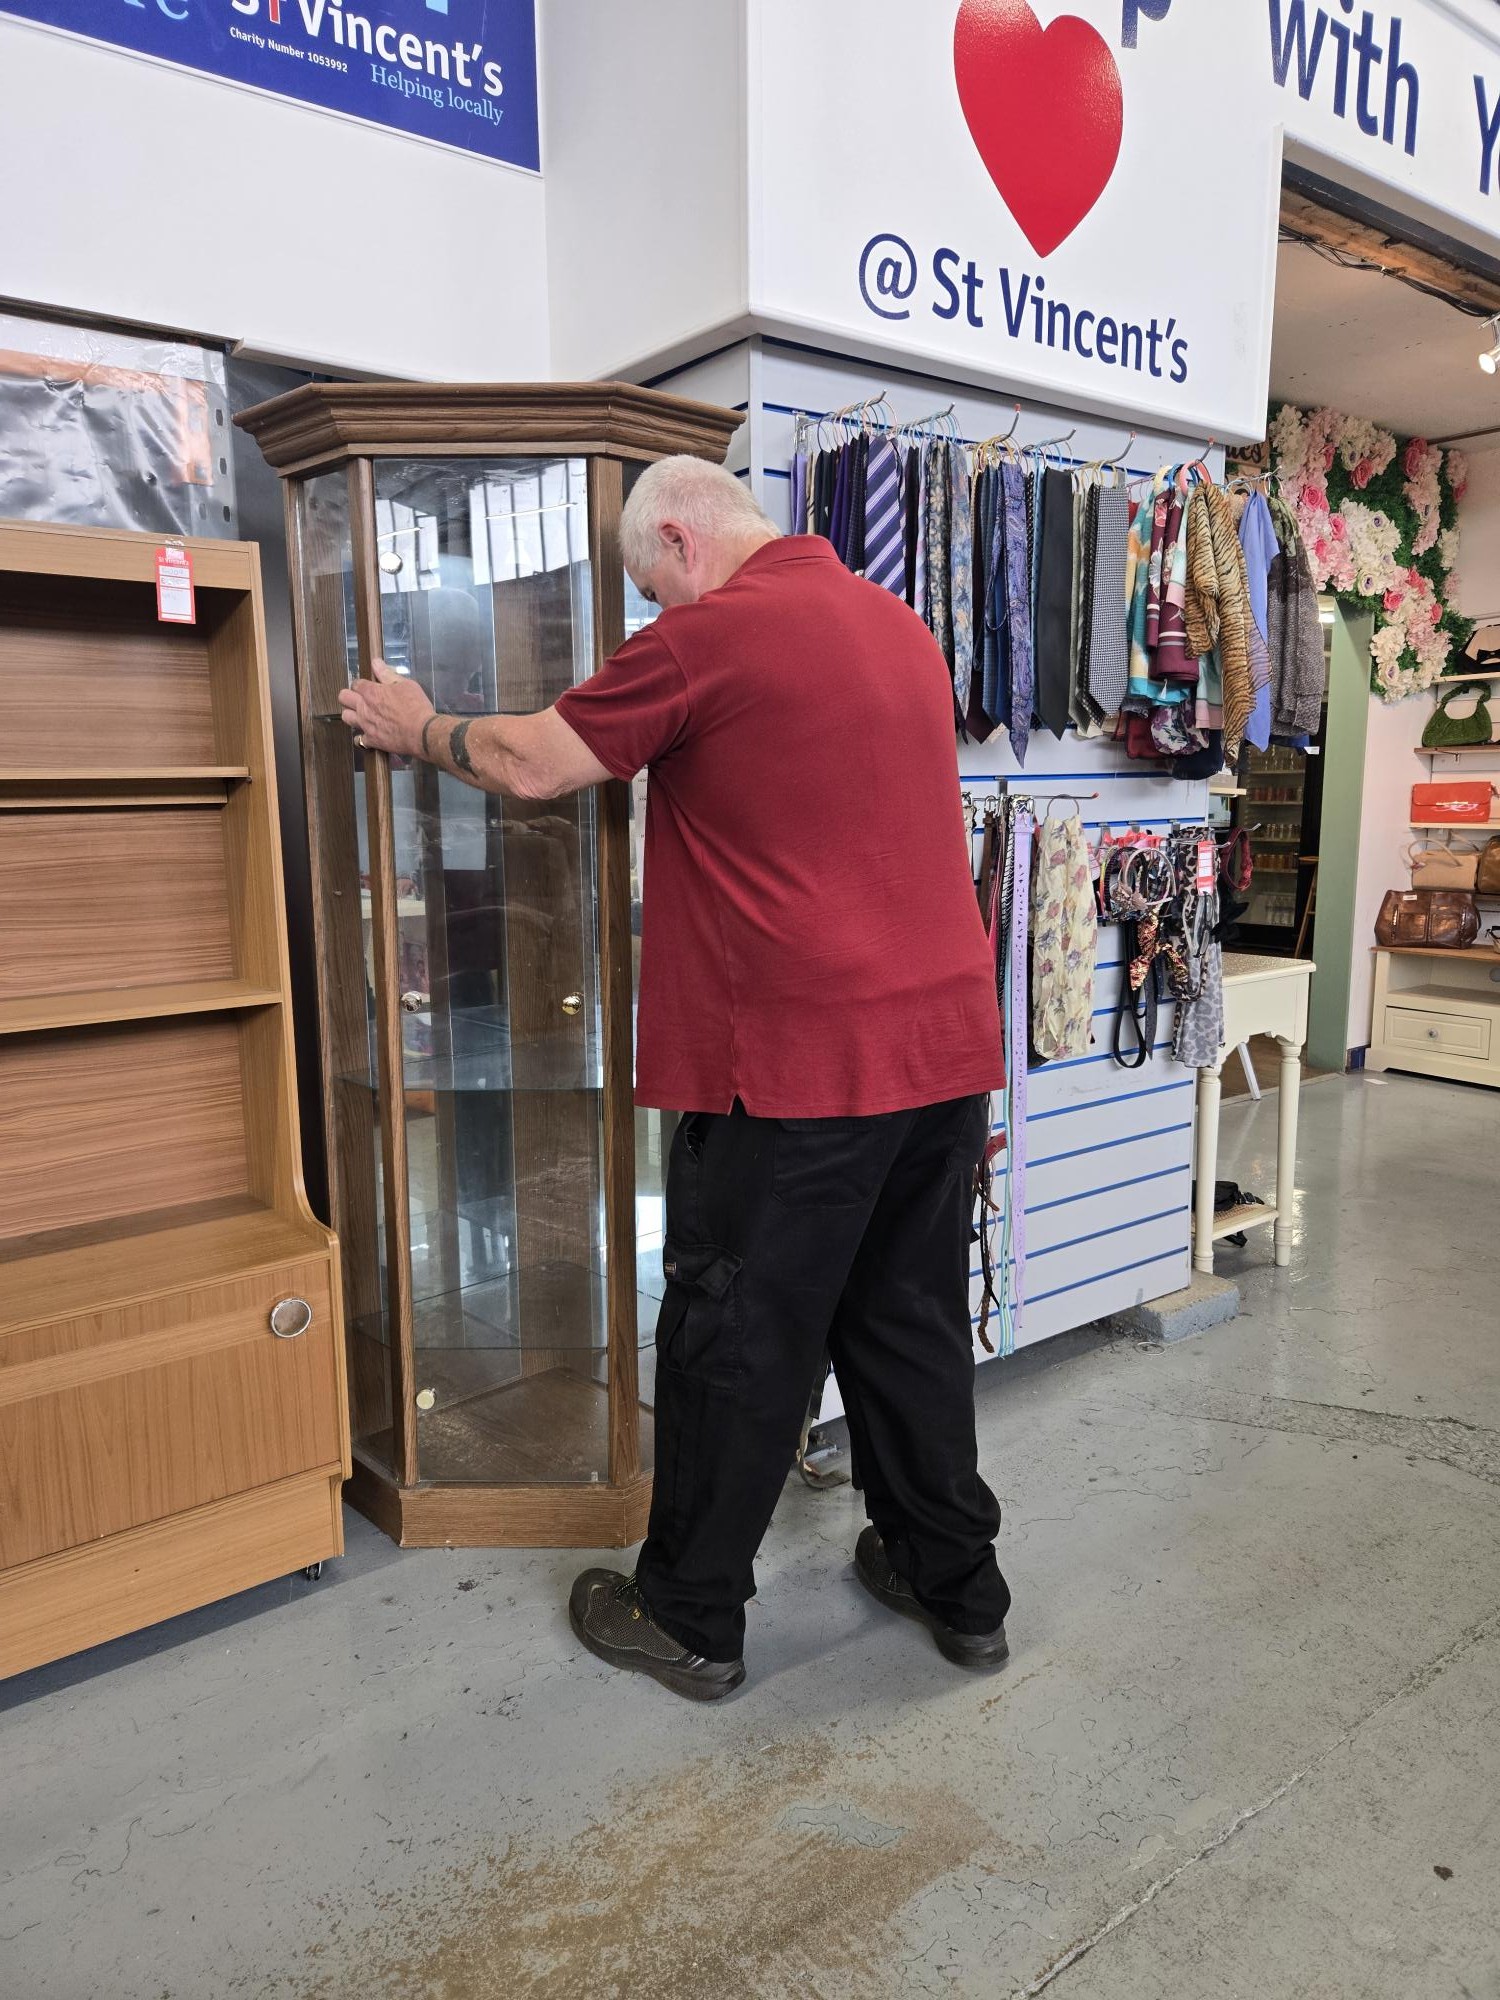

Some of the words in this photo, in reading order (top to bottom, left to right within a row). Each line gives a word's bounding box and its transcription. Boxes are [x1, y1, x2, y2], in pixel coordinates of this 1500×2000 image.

[229, 25, 266, 49] Charity
[268, 38, 305, 59] Number
[307, 52, 348, 73] 1053992
[370, 63, 444, 108] Helping
[449, 87, 504, 126] locally
[858, 233, 918, 321] @
[932, 247, 984, 328] St
[998, 267, 1189, 384] Vincent's
